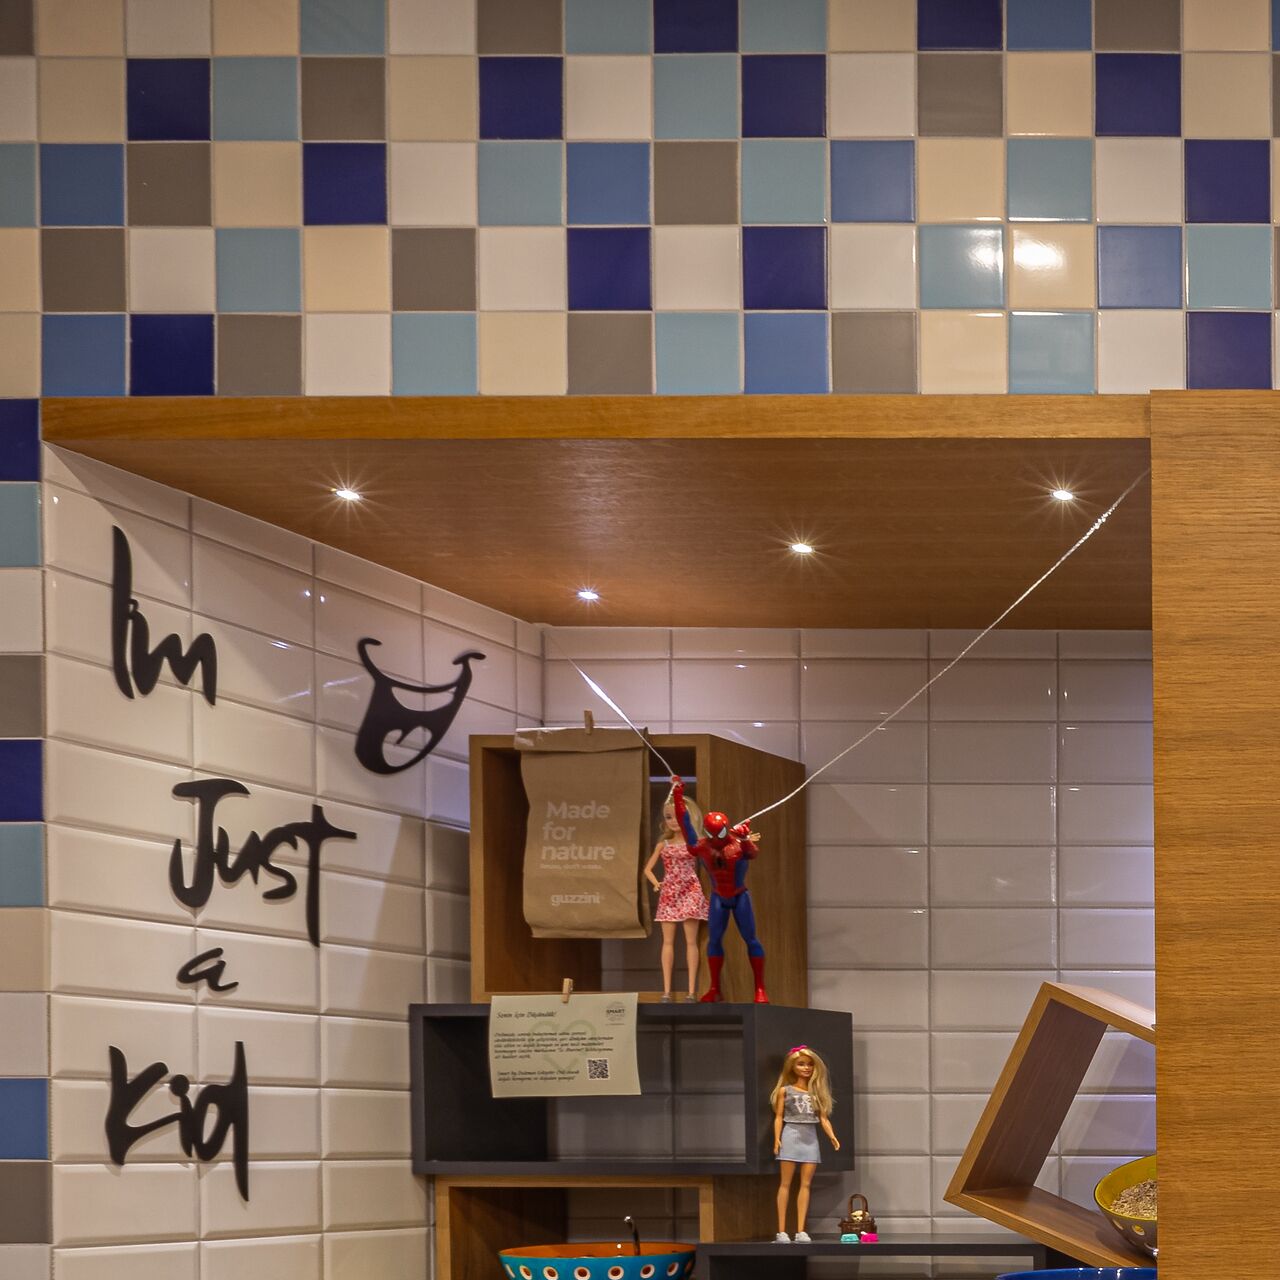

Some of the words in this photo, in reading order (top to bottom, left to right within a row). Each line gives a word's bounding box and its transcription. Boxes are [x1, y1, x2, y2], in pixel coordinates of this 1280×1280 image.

[546, 800, 610, 819] Made
[542, 821, 576, 840] for
[541, 843, 615, 860] nature
[170, 778, 357, 948] Just
[551, 892, 600, 906] guzzini
[177, 947, 239, 992] a
[105, 1041, 249, 1202] Kid
